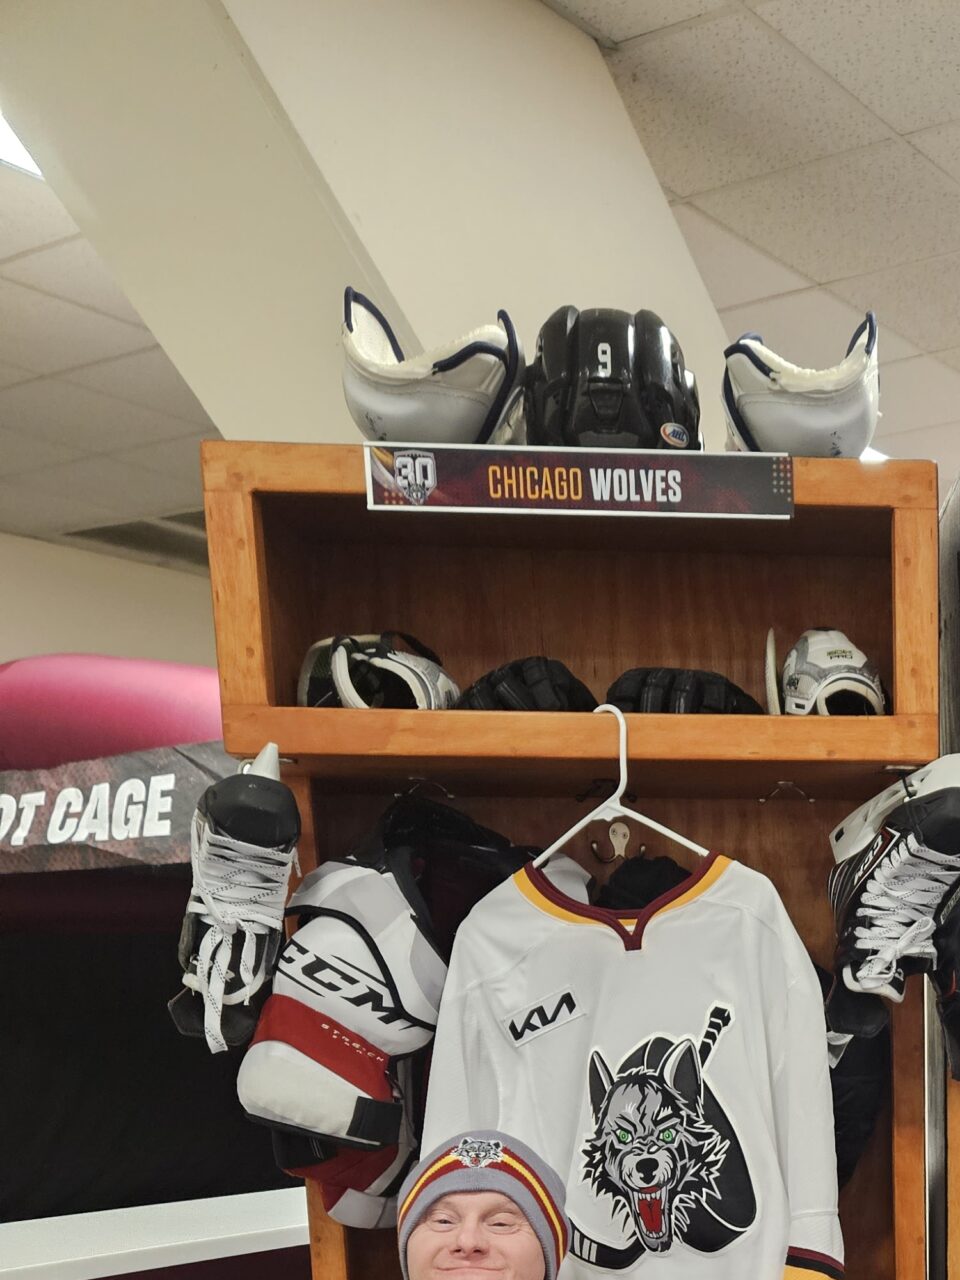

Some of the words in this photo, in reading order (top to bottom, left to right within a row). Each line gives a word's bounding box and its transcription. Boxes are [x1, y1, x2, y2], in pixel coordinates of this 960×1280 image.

[597, 342, 612, 378] 9
[395, 456, 435, 489] 30
[488, 464, 583, 501] CHICAGO
[589, 467, 682, 503] WOLVES
[47, 773, 175, 845] CAGE
[280, 938, 401, 1025] CCM
[508, 991, 577, 1041] KIA
